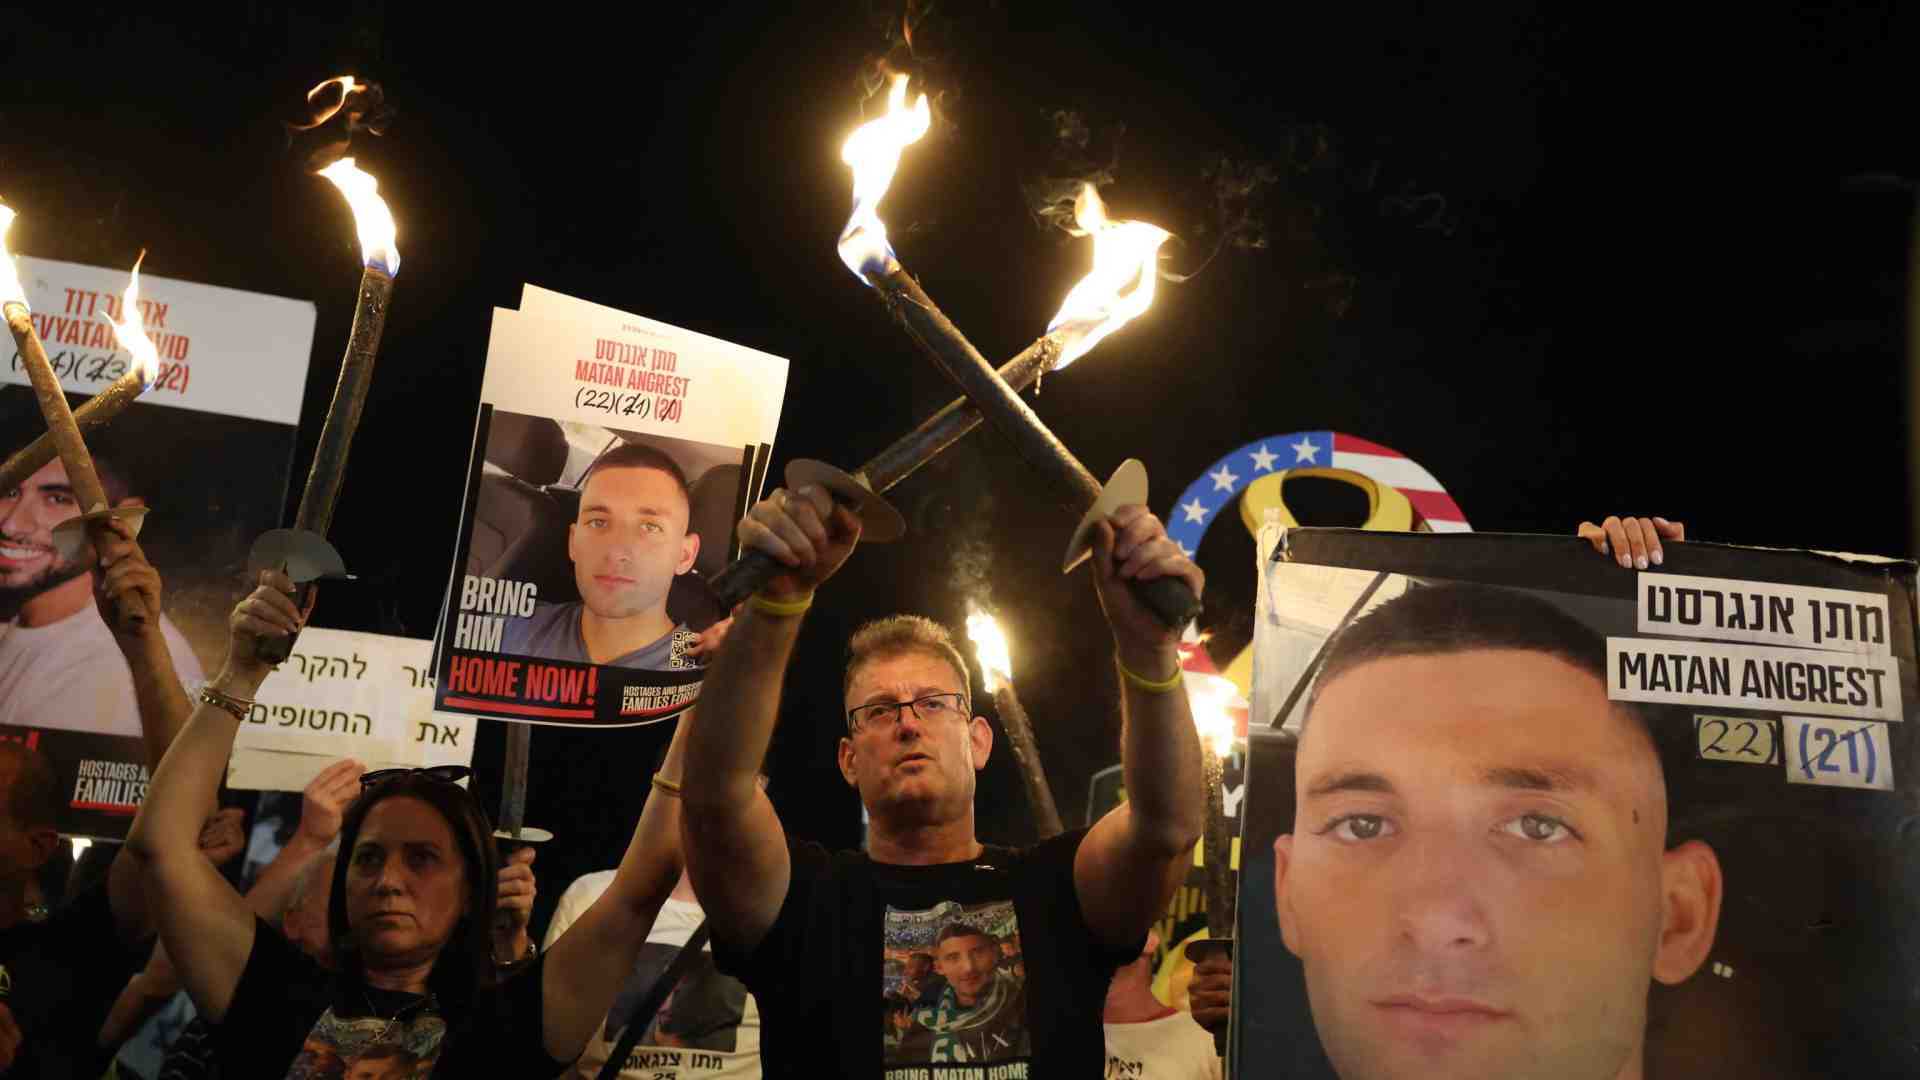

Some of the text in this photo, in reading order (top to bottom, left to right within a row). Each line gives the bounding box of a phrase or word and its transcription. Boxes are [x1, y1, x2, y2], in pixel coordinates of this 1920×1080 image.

[595, 338, 677, 372] מתן אנגרסט
[575, 360, 691, 398] MATAN ANGREST
[459, 575, 537, 618] BRING
[1647, 584, 1885, 644] מתן אנגרסט
[453, 613, 505, 652] HIM
[449, 655, 520, 694] HOME
[623, 685, 661, 697] HOSTAGES
[1618, 651, 1886, 709] MATAN ANGREST
[622, 694, 669, 712] FAMILIES
[249, 702, 460, 747] את החטופים
[78, 759, 138, 781] HOSTAGES
[885, 1062, 1028, 1080] BRING MATAN HOME
